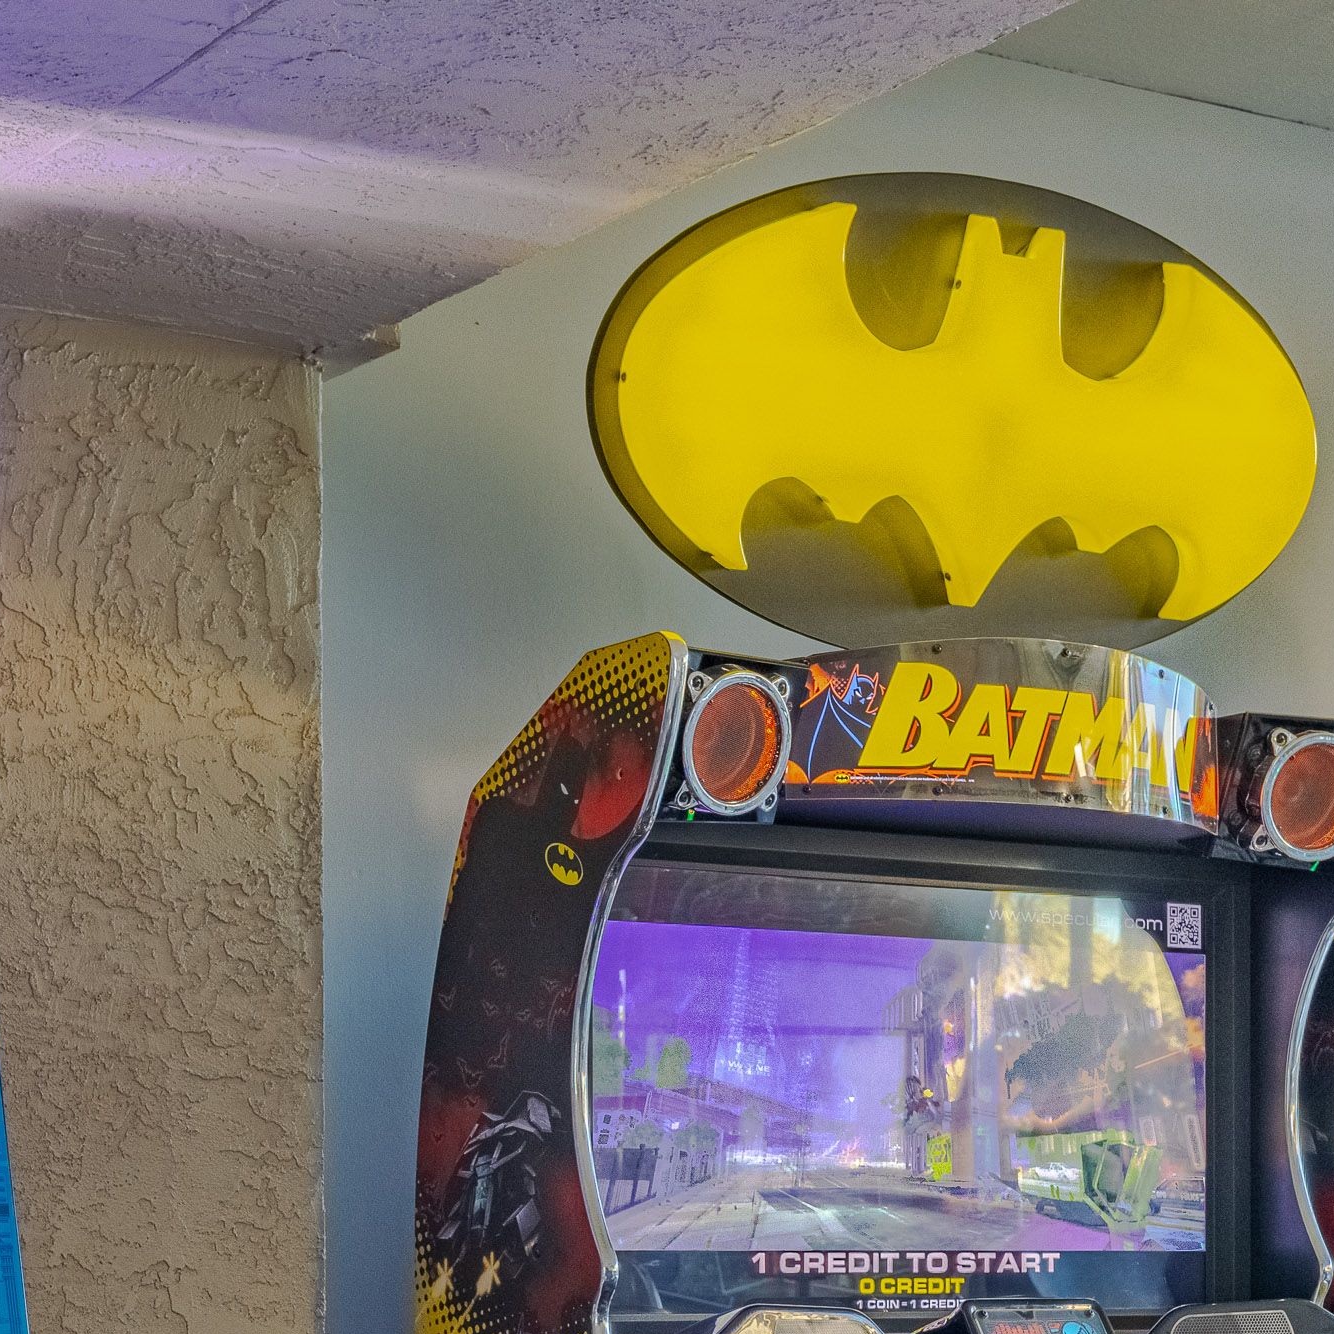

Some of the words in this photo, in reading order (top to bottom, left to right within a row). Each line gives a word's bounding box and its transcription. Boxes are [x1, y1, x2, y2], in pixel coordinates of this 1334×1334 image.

[857, 661, 1197, 793] BATMAN
[751, 1252, 766, 1274] 1
[779, 1252, 899, 1274] CREDIT
[906, 1252, 949, 1274] TO
[956, 1252, 1061, 1274] START
[859, 1277, 876, 1295] 0
[880, 1277, 965, 1294] CREDIT
[856, 1299, 863, 1309] 1
